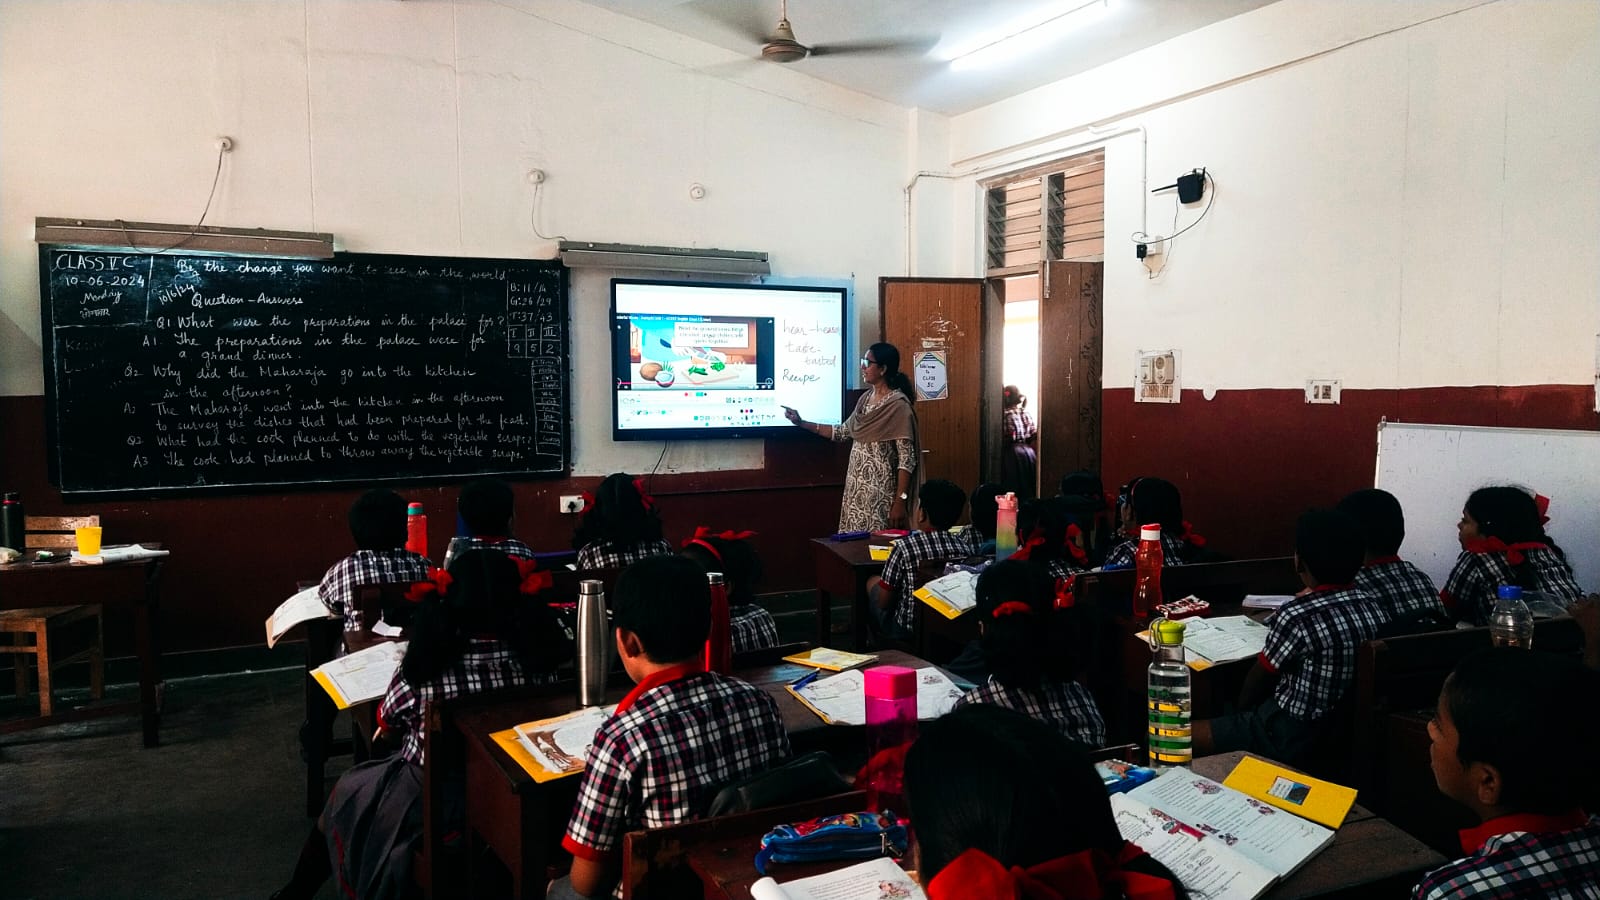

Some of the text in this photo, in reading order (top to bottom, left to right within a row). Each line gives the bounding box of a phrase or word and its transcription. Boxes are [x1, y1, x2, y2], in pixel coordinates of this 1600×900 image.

[52, 253, 104, 272] CLASS
[123, 256, 135, 268] C
[177, 259, 195, 273] Be
[203, 260, 228, 273] the
[235, 260, 283, 277] change
[293, 263, 314, 278] you
[321, 262, 354, 274] want
[417, 267, 430, 277] in
[439, 266, 464, 279] the
[470, 268, 506, 281] world
[65, 275, 145, 288] 10-06-2024
[191, 292, 244, 309] Question
[178, 313, 215, 329] What
[233, 319, 262, 328] were
[270, 315, 291, 326] the
[304, 314, 370, 329] preparations
[381, 315, 394, 326] in
[399, 313, 416, 327] the
[174, 331, 201, 346] The
[217, 333, 302, 353] preparations
[314, 333, 332, 346] in
[341, 331, 366, 346] the
[376, 333, 421, 349] palace
[469, 334, 486, 352] for
[545, 344, 555, 354] 2
[179, 350, 187, 359] a
[202, 350, 242, 367] grand
[153, 364, 181, 385] Why
[197, 365, 220, 379] did
[228, 365, 248, 378] the
[259, 365, 327, 385] Maharaja
[341, 369, 353, 385] go
[362, 366, 387, 377] into
[393, 364, 412, 377] the
[425, 364, 477, 377] kitchen
[783, 368, 820, 385] Recipe
[163, 388, 178, 399] in
[189, 385, 207, 397] the
[151, 401, 179, 416] The
[190, 401, 250, 418] Maharaja
[264, 401, 292, 412] went
[301, 400, 324, 411] into
[329, 396, 350, 408] the
[358, 395, 401, 407] kitchen
[411, 394, 423, 405] in
[427, 392, 444, 402] the
[453, 392, 504, 403] afternoon
[156, 420, 167, 431] to
[177, 420, 218, 434] survey
[226, 418, 244, 429] the
[254, 416, 292, 427] dishes
[299, 415, 325, 428] that
[337, 414, 357, 426] had
[366, 413, 393, 425] been
[402, 412, 451, 427] prepared
[457, 412, 472, 431] for
[477, 413, 492, 425] the
[157, 432, 187, 447] What
[197, 433, 220, 447] had
[228, 431, 247, 445] the
[257, 429, 285, 444] cook
[293, 431, 340, 447] planned
[349, 432, 358, 442] to
[368, 430, 379, 441] do
[387, 430, 414, 441] with
[421, 430, 433, 441] the
[163, 450, 185, 466] The
[193, 452, 220, 466] cook
[230, 450, 255, 464] had
[264, 448, 313, 466] planned
[321, 446, 332, 459] to
[342, 445, 375, 457] throw
[381, 447, 413, 461] away
[421, 446, 438, 457] the
